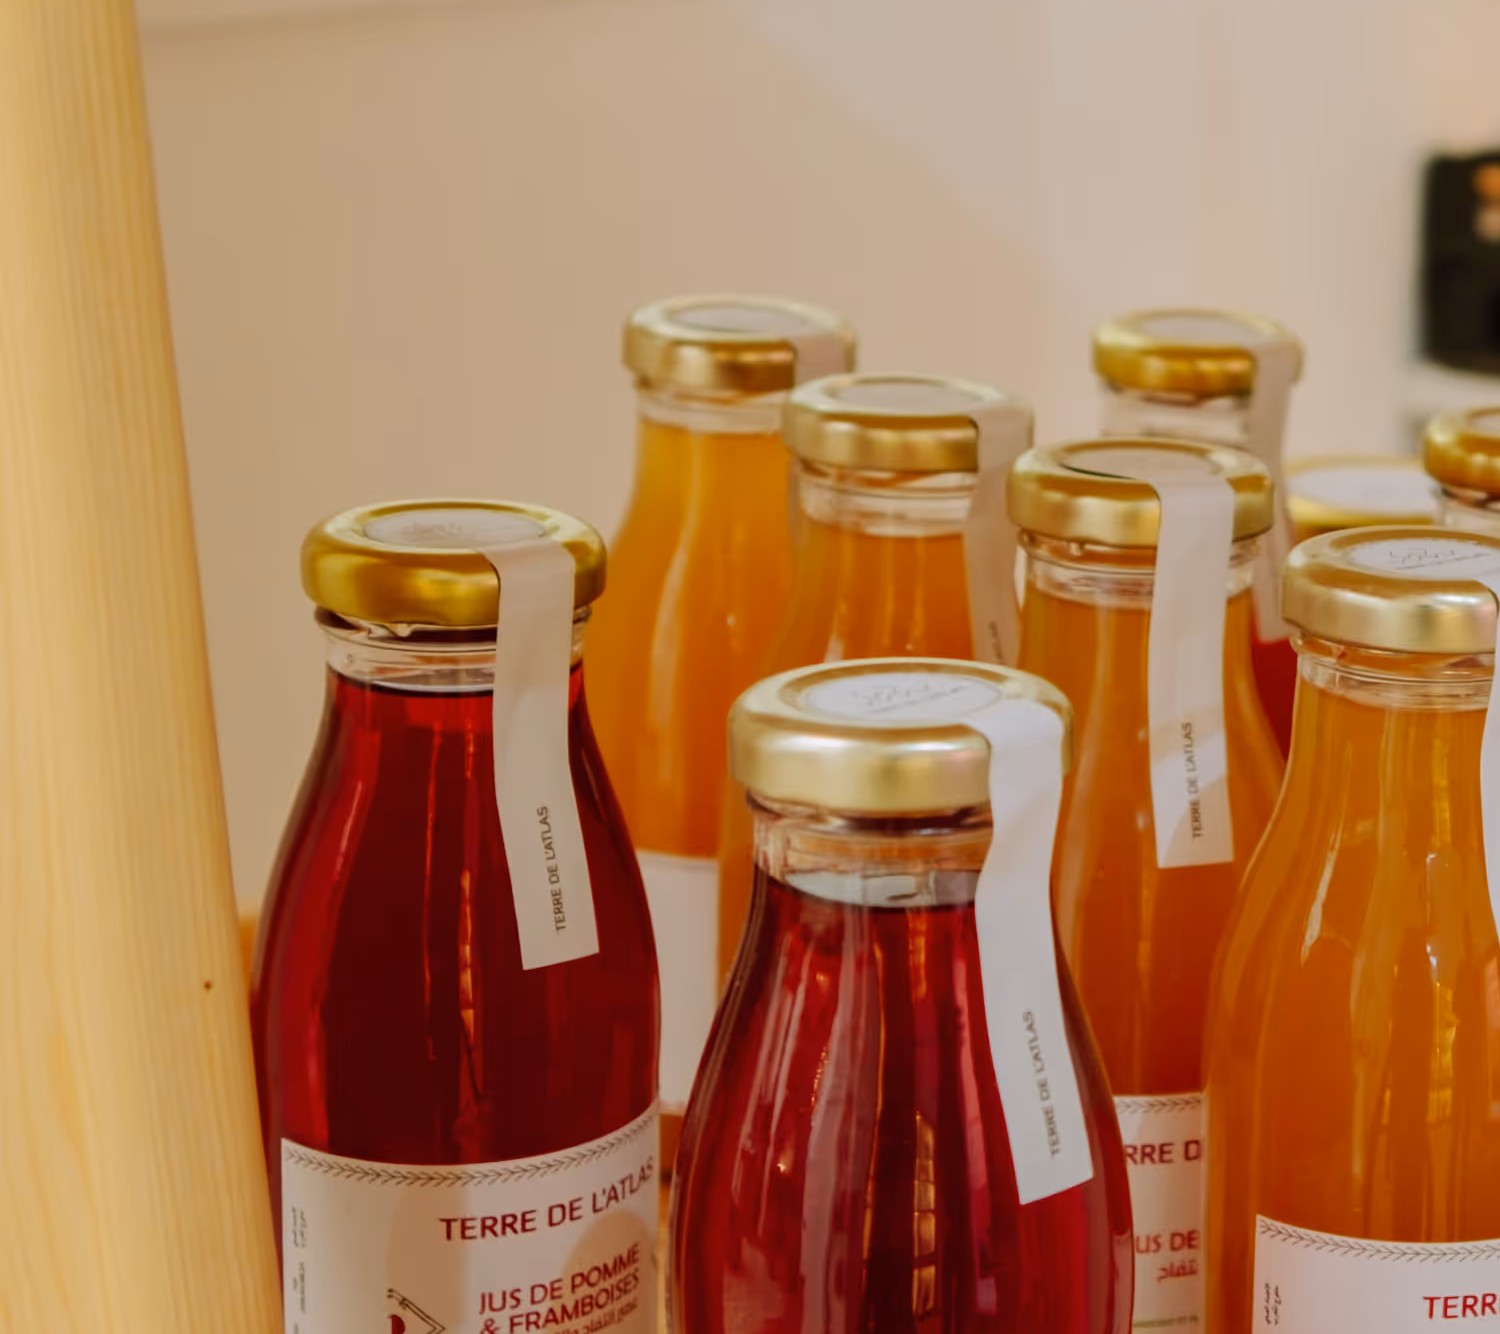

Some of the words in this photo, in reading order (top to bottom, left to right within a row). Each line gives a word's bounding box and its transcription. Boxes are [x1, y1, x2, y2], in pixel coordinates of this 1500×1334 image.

[1181, 722, 1195, 773] L'ATLAS
[1186, 775, 1198, 795] DE
[536, 805, 557, 861] L'ATLAS
[1190, 798, 1203, 839] TERRE
[548, 861, 560, 884] DE
[552, 884, 567, 932] TERRE
[1022, 1010, 1046, 1076] L'ATLAS
[1035, 1076, 1050, 1105] DE
[1041, 1105, 1061, 1158] TERRE
[440, 1208, 537, 1242] TERRE
[548, 1196, 584, 1229] DE
[592, 1154, 653, 1215] L'ATLAS
[478, 1286, 522, 1317] JUS
[529, 1278, 563, 1306] DE
[570, 1241, 640, 1294] POMME
[509, 1267, 640, 1334] FRAMBOISES
